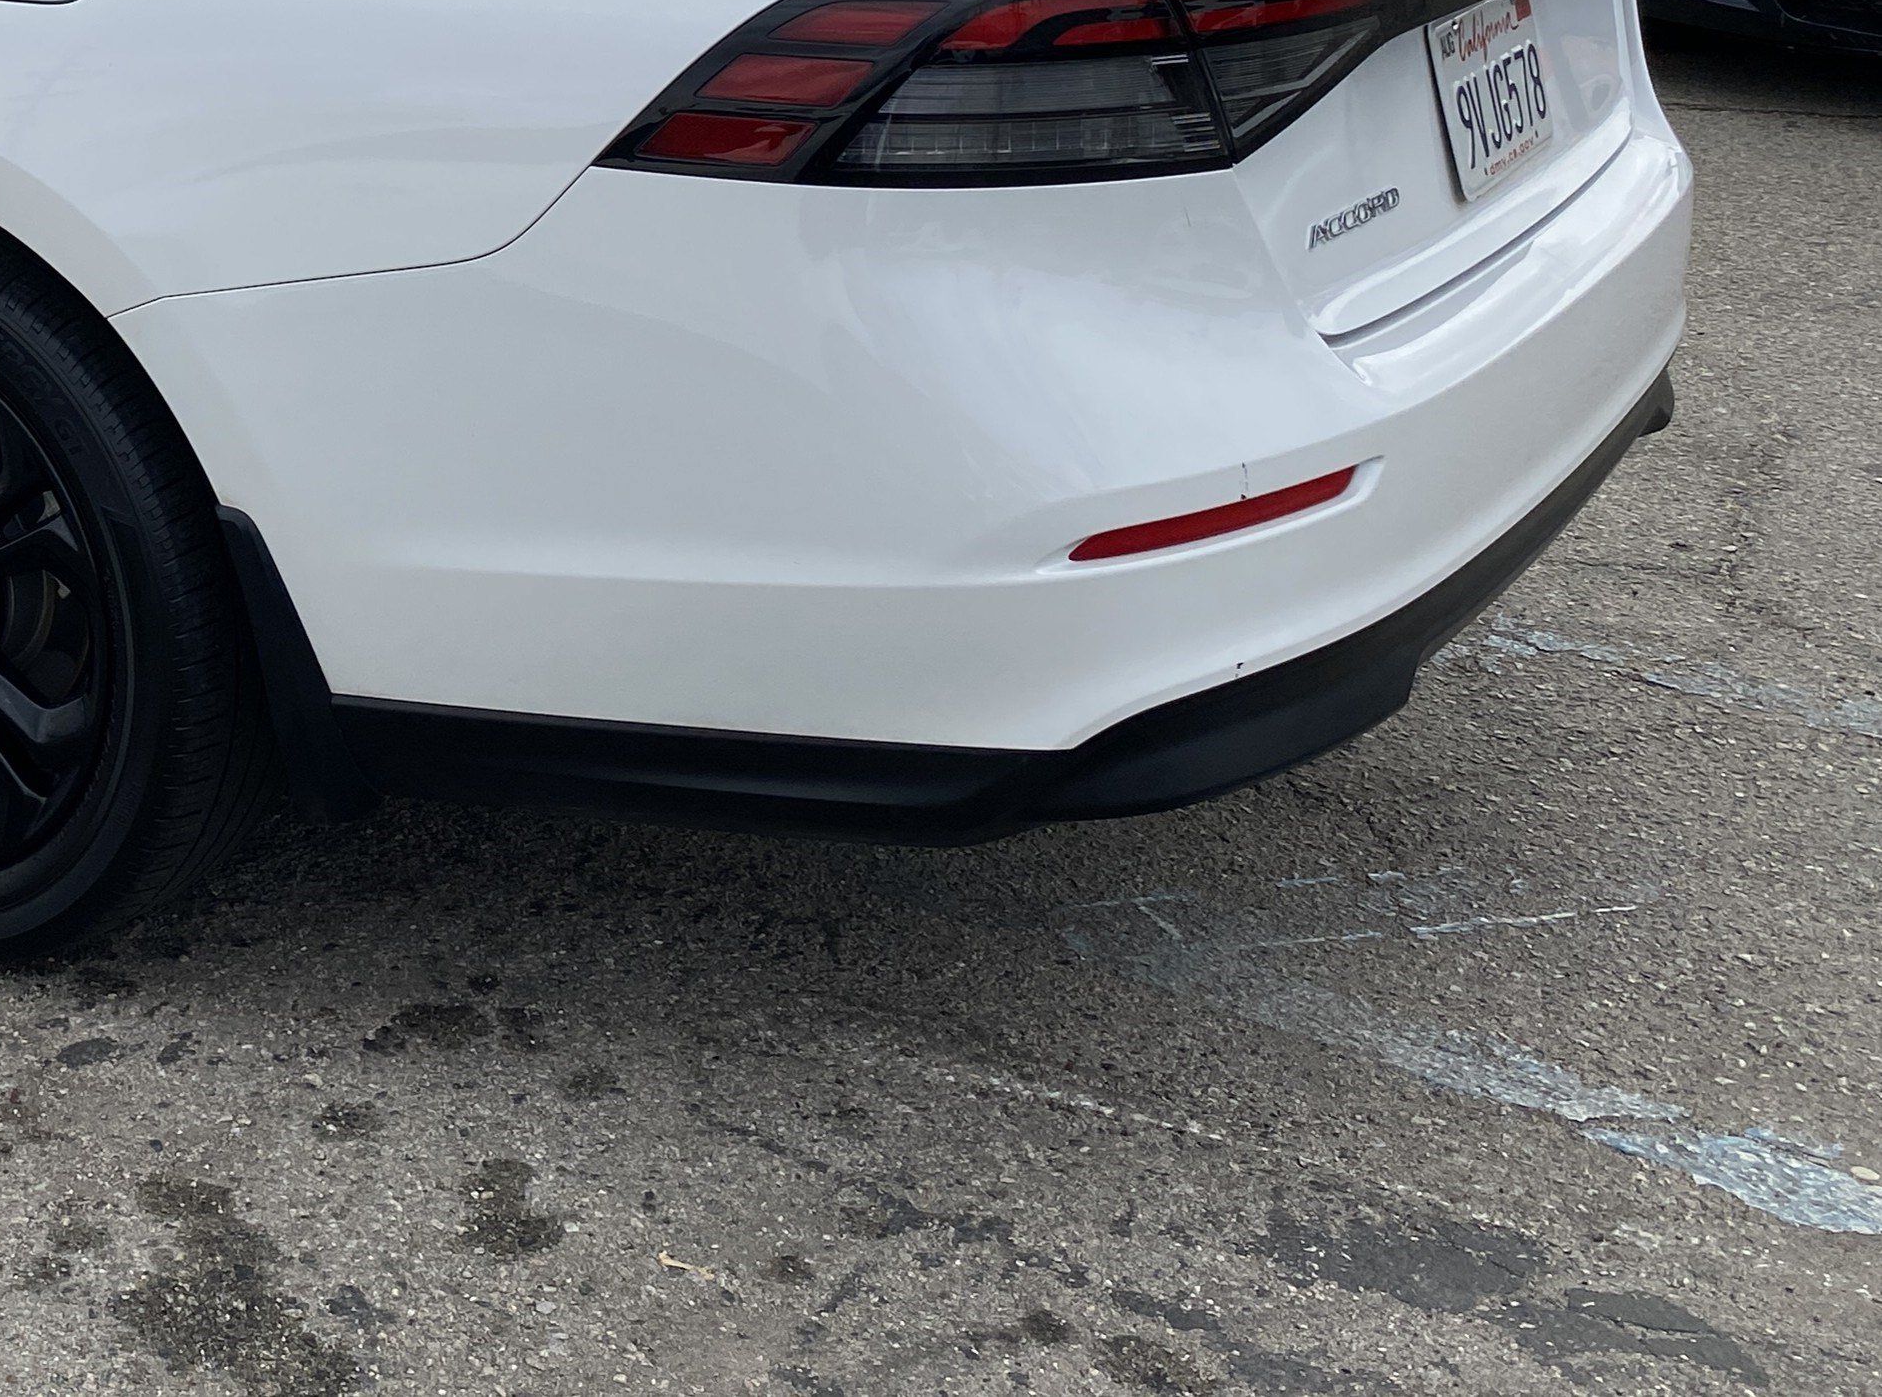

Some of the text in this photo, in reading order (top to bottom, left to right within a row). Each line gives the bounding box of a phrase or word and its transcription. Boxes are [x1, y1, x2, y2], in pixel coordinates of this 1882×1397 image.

[1458, 9, 1519, 63] California
[1454, 39, 1547, 170] 9VJG578
[1306, 187, 1400, 251] ACCORD
